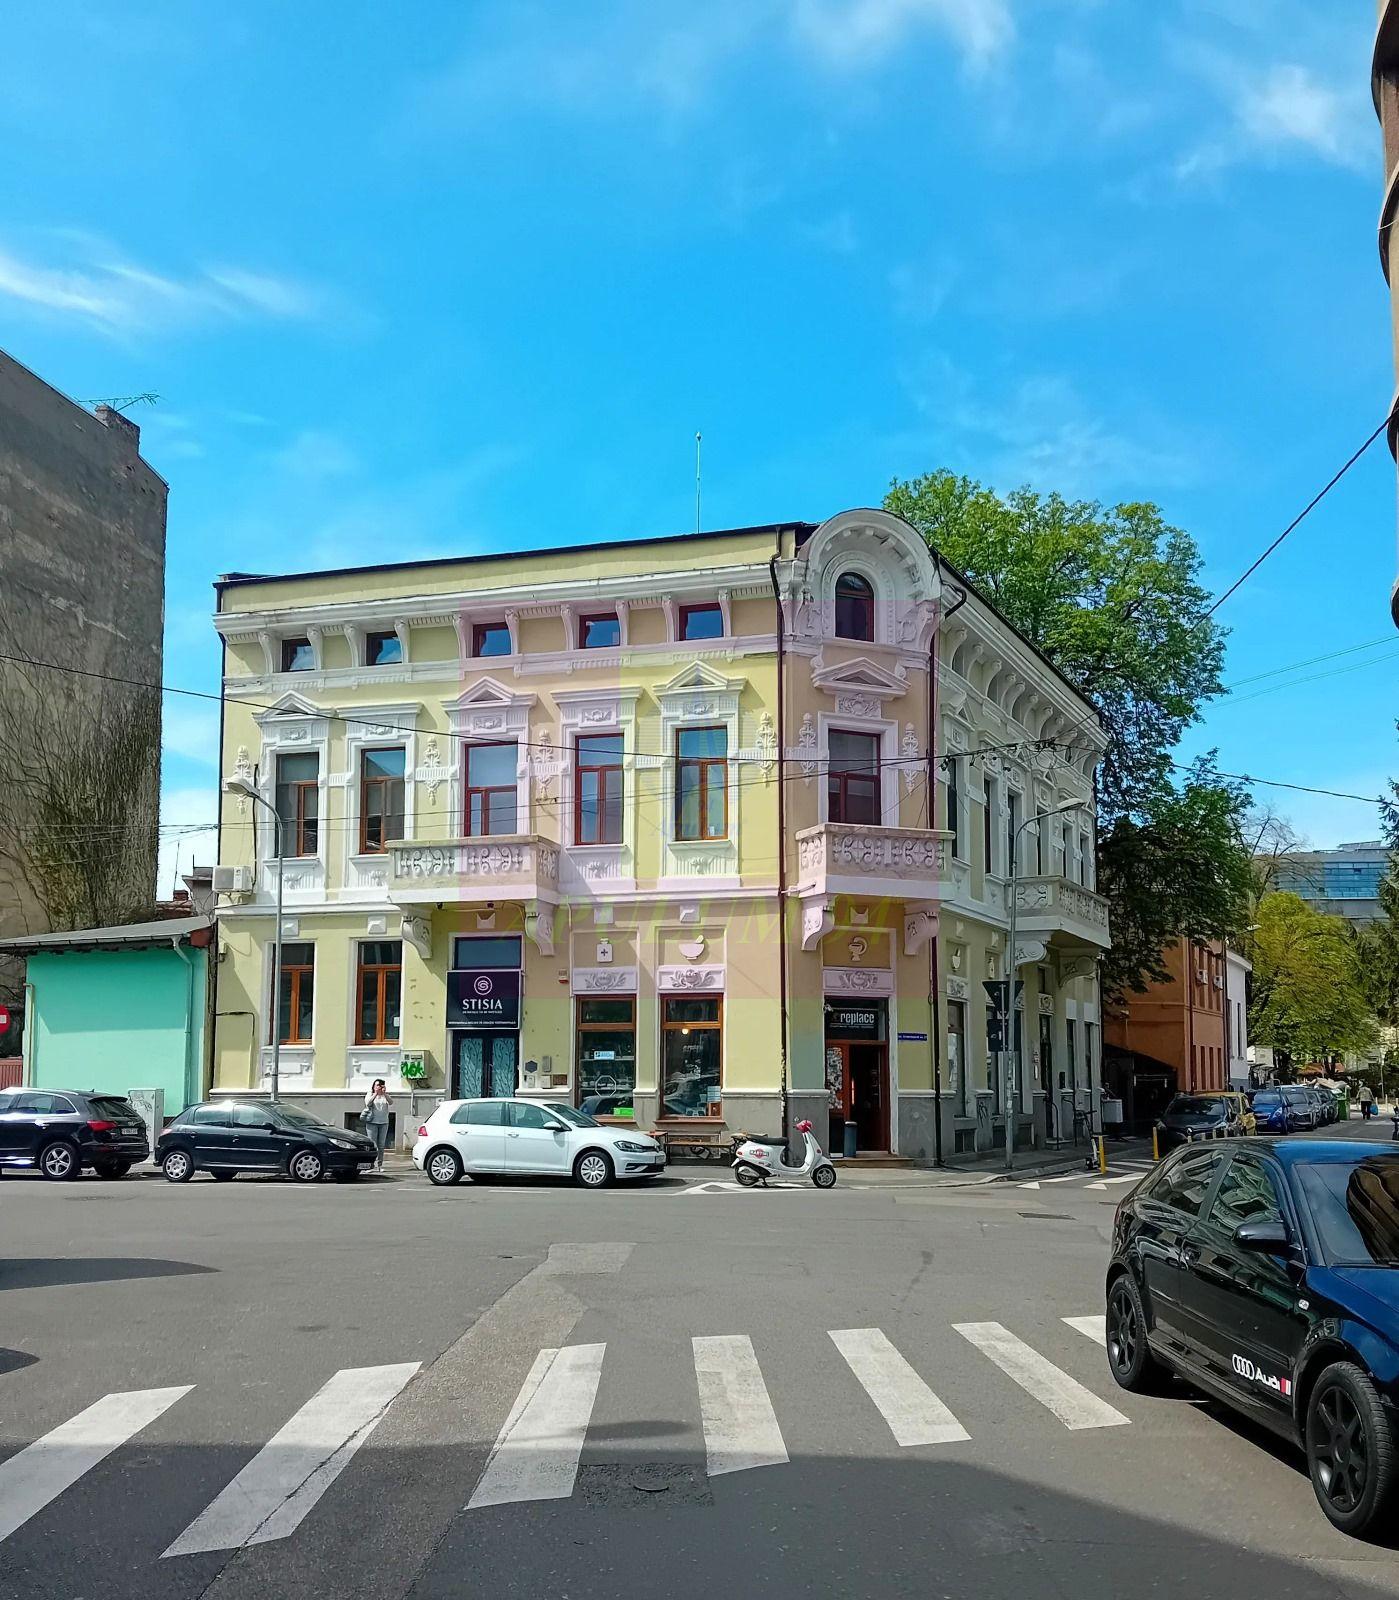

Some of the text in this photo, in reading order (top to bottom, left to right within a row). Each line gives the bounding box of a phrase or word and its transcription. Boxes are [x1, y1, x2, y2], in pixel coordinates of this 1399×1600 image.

[462, 998, 503, 1010] STISIA
[840, 1011, 875, 1025] replace
[1254, 1367, 1281, 1392] Audi
